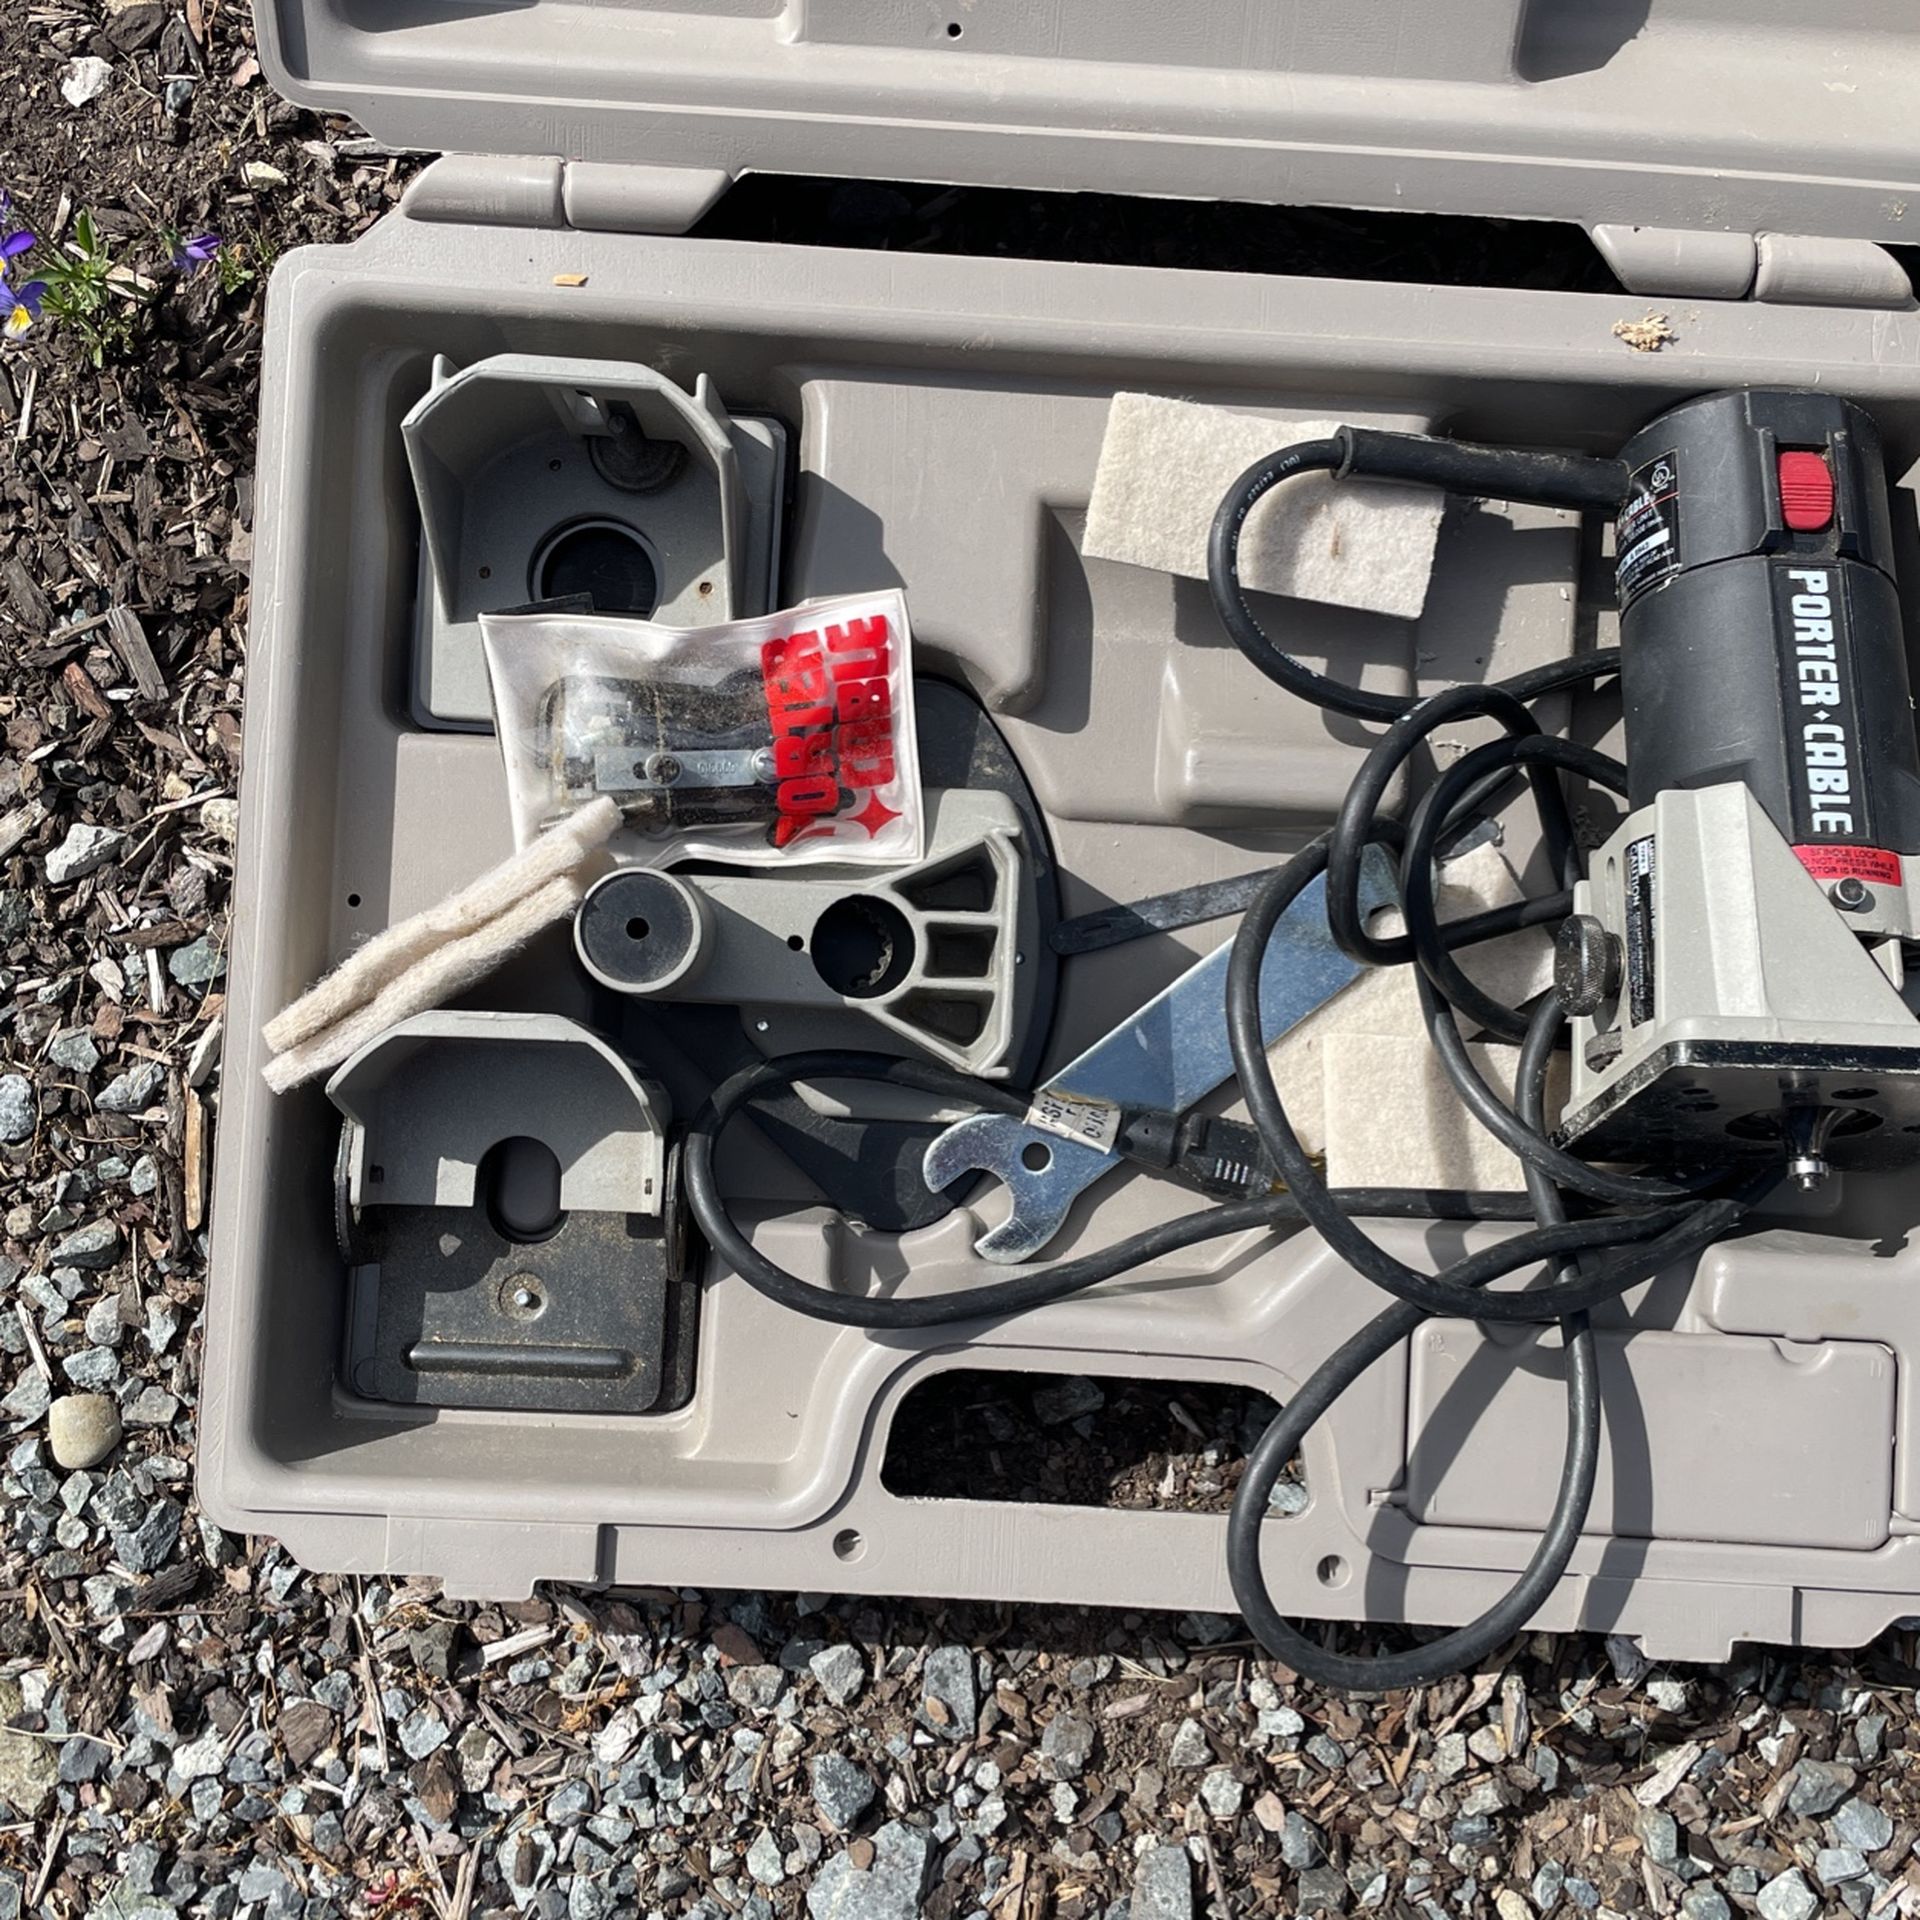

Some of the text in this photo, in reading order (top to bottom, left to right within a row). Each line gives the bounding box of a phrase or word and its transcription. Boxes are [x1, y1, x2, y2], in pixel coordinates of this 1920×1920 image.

[825, 614, 895, 789] CABLE
[1789, 570, 1853, 833] PORTER CABLE
[761, 630, 839, 847] PORTER
[1630, 844, 1641, 907] CAUTION
[1808, 866, 1892, 880] OTOR IS RUNNING
[1811, 848, 1878, 859] SPINDLE LOCK
[1812, 857, 1833, 865] NOT
[1836, 857, 1868, 867] PRESS
[1871, 861, 1895, 872] WHILE
